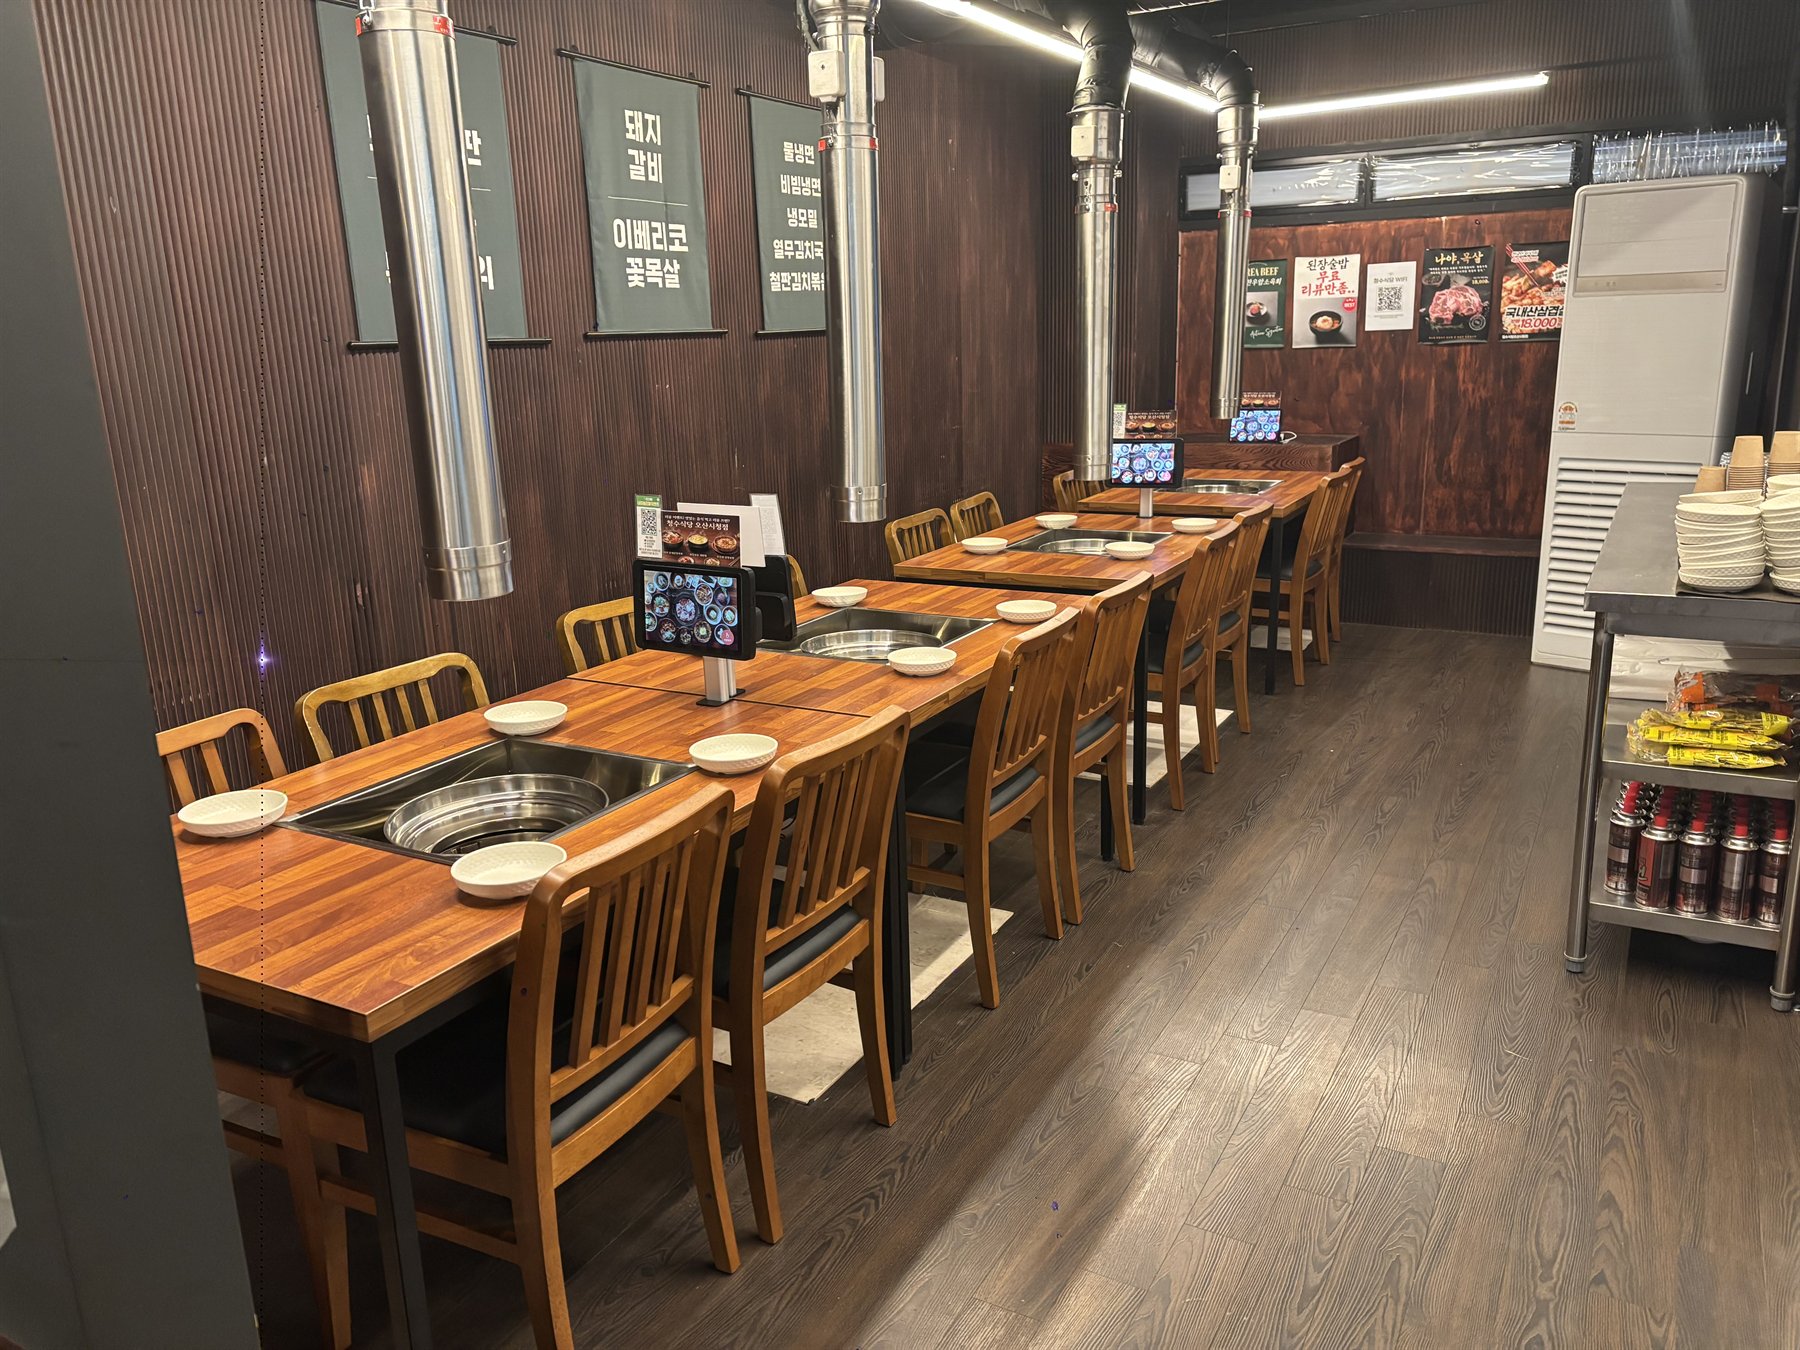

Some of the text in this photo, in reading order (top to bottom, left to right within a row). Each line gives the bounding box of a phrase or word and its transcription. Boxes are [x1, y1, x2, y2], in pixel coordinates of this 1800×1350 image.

[624, 109, 661, 145] 돼지
[783, 141, 815, 165] 물냉면
[628, 149, 663, 183] 갈비
[780, 174, 822, 197] 비빔냉면
[787, 207, 818, 229] 냉모밀
[613, 218, 689, 252] 이베리코
[773, 239, 824, 260] 열무김치국
[626, 257, 680, 288] 꽃목살
[1247, 267, 1279, 277] REA BEEF
[1317, 271, 1340, 283] 무료
